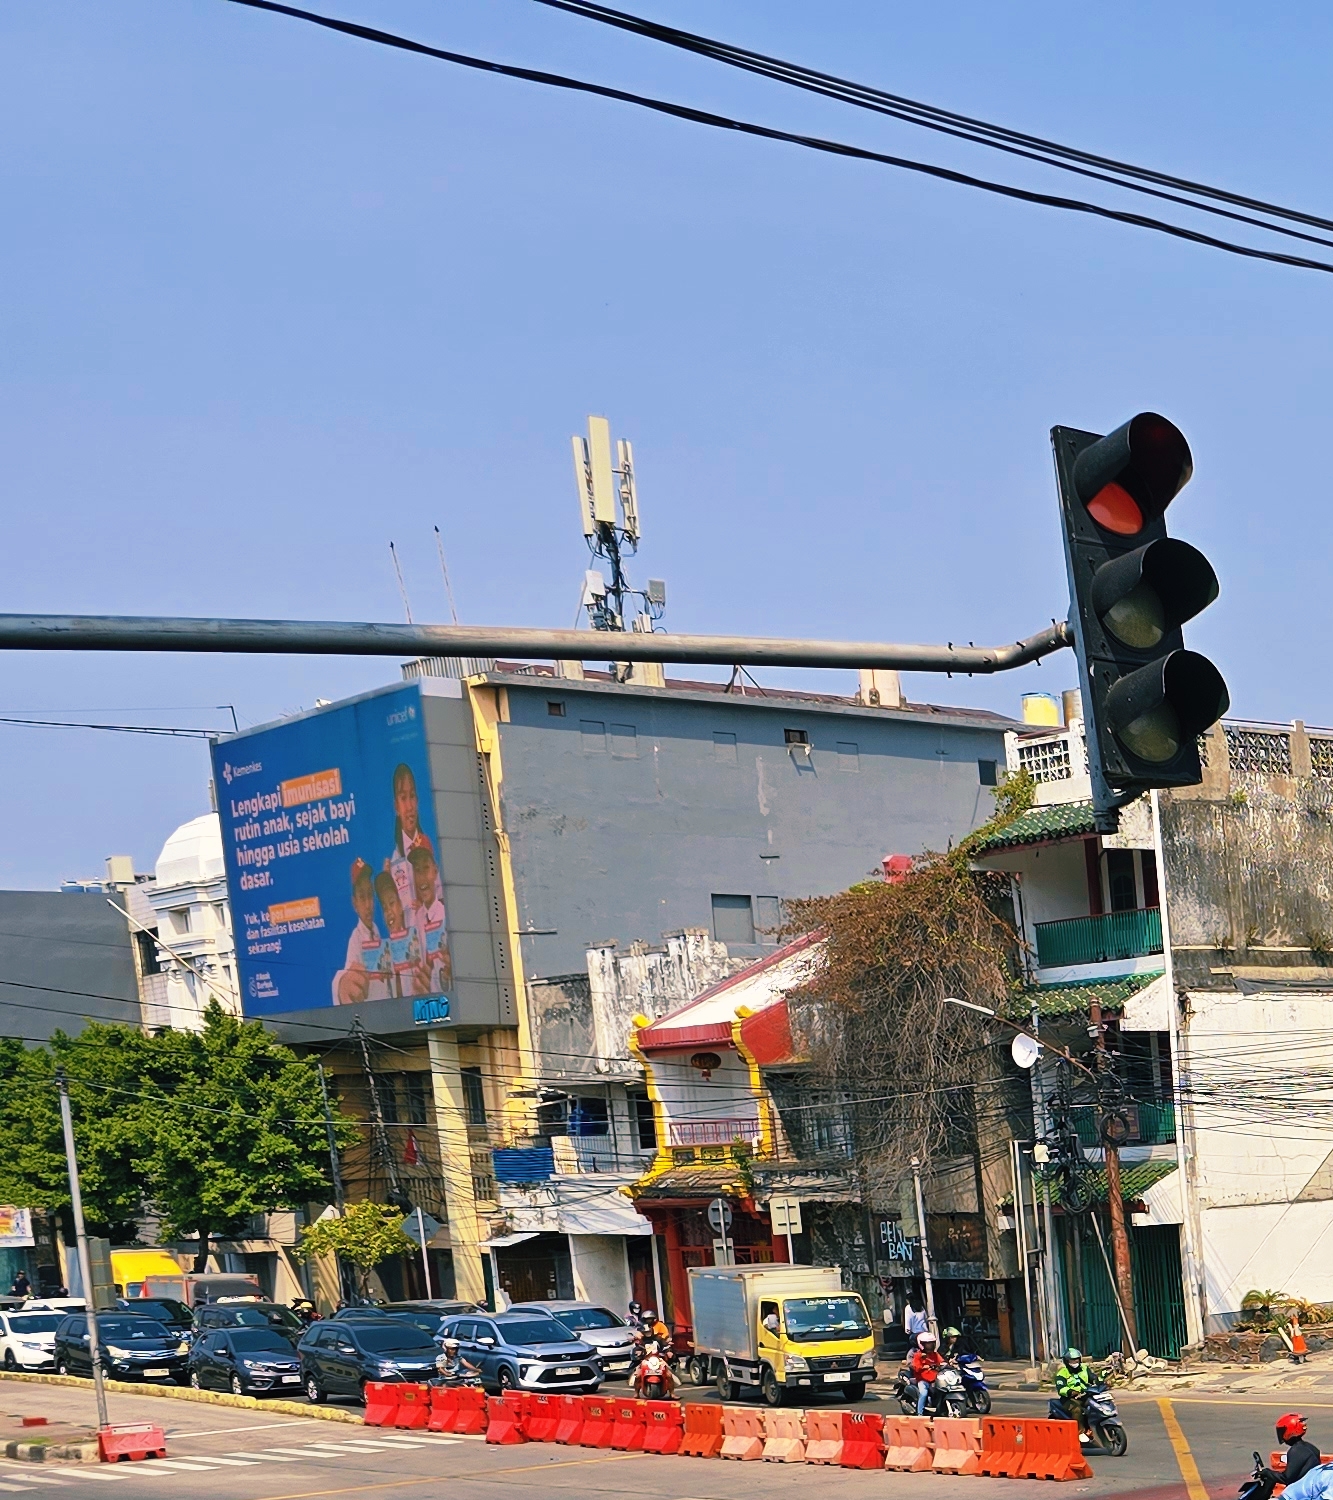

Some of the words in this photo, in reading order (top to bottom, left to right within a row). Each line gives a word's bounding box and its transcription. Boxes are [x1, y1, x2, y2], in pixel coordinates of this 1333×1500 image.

[233, 762, 262, 777] Kemenkes
[231, 785, 282, 818] Lengkapi
[283, 771, 340, 805] imunisasi
[234, 818, 262, 842] rutin
[263, 812, 294, 833] anak,
[296, 803, 327, 830] sejak
[329, 793, 356, 821] bayi
[236, 845, 276, 867] hingga
[277, 834, 300, 857] usia
[303, 824, 350, 852] sekolah
[240, 871, 274, 890] dasar.
[244, 912, 260, 925] Yuk,
[260, 911, 270, 922] ke
[246, 928, 260, 940] dan
[260, 924, 287, 938] fasilitas
[288, 917, 325, 934] kesehatan
[248, 939, 282, 955] sekarang!
[888, 1242, 913, 1261] BAN
